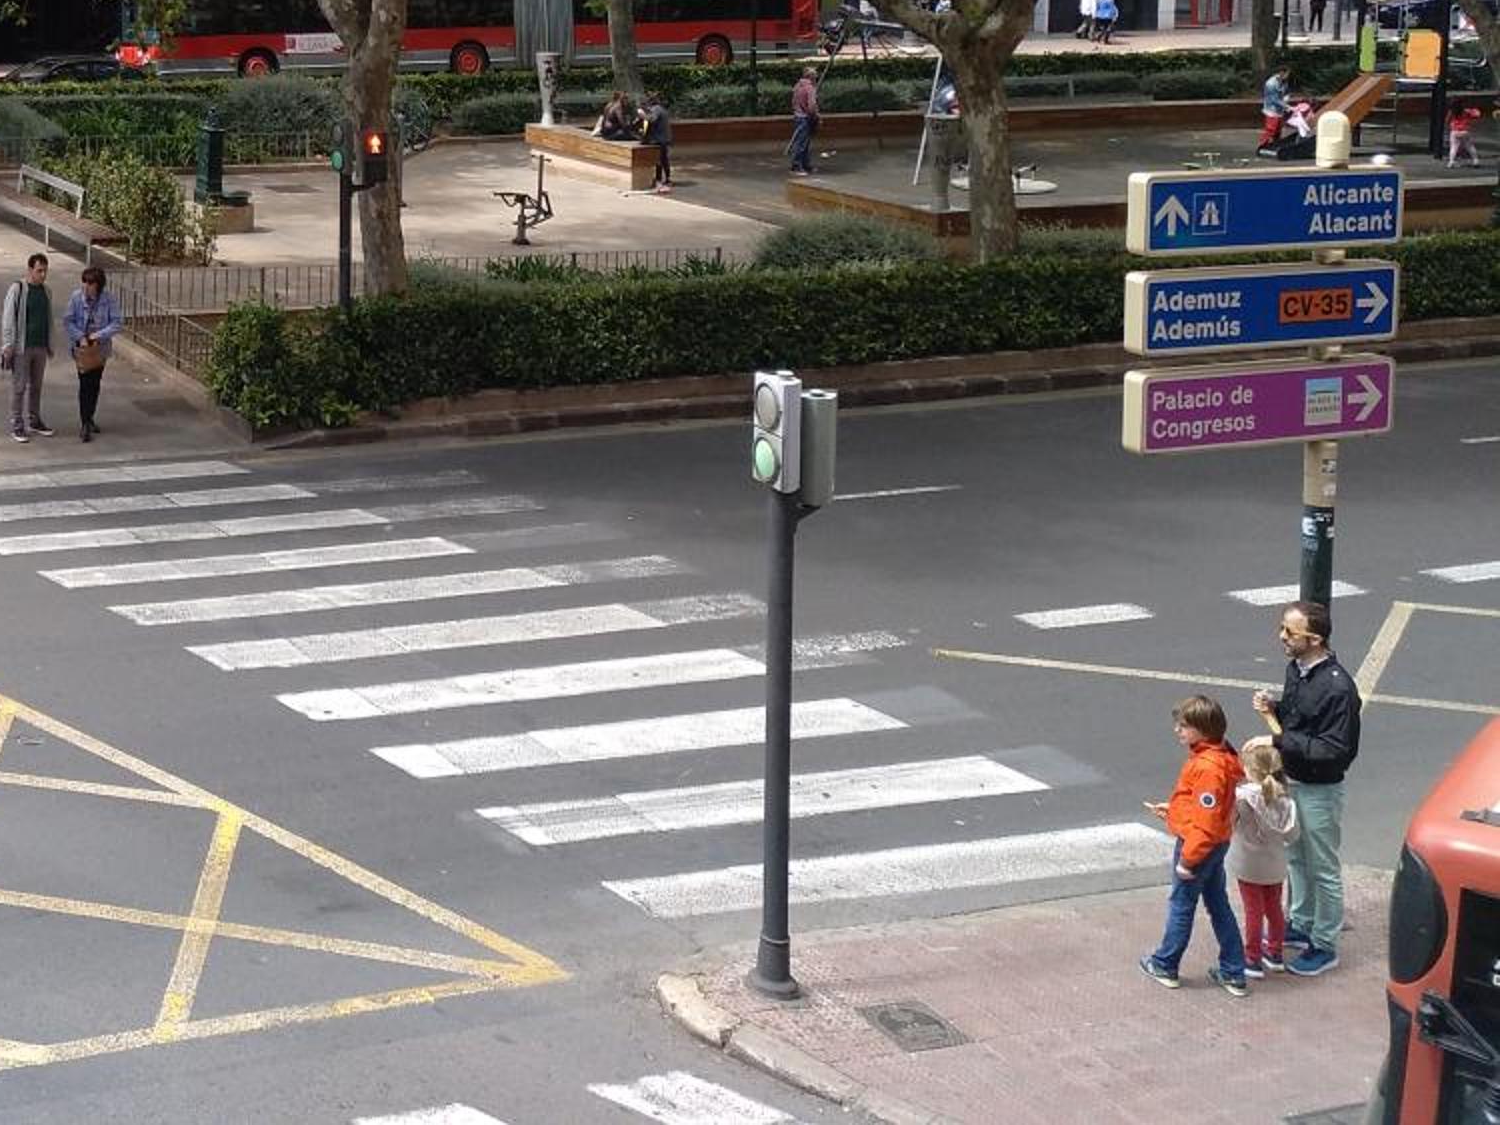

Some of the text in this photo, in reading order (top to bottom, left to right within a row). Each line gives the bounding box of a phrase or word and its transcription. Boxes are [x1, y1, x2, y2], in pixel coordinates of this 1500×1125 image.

[1303, 183, 1394, 206] Alicante
[1308, 213, 1394, 235] Alacant
[1153, 290, 1242, 312] Ademuz
[1283, 293, 1349, 318] CV-35
[1152, 316, 1241, 341] Ademús
[1152, 385, 1253, 412] Palacio de
[1152, 412, 1256, 440] Congresos
